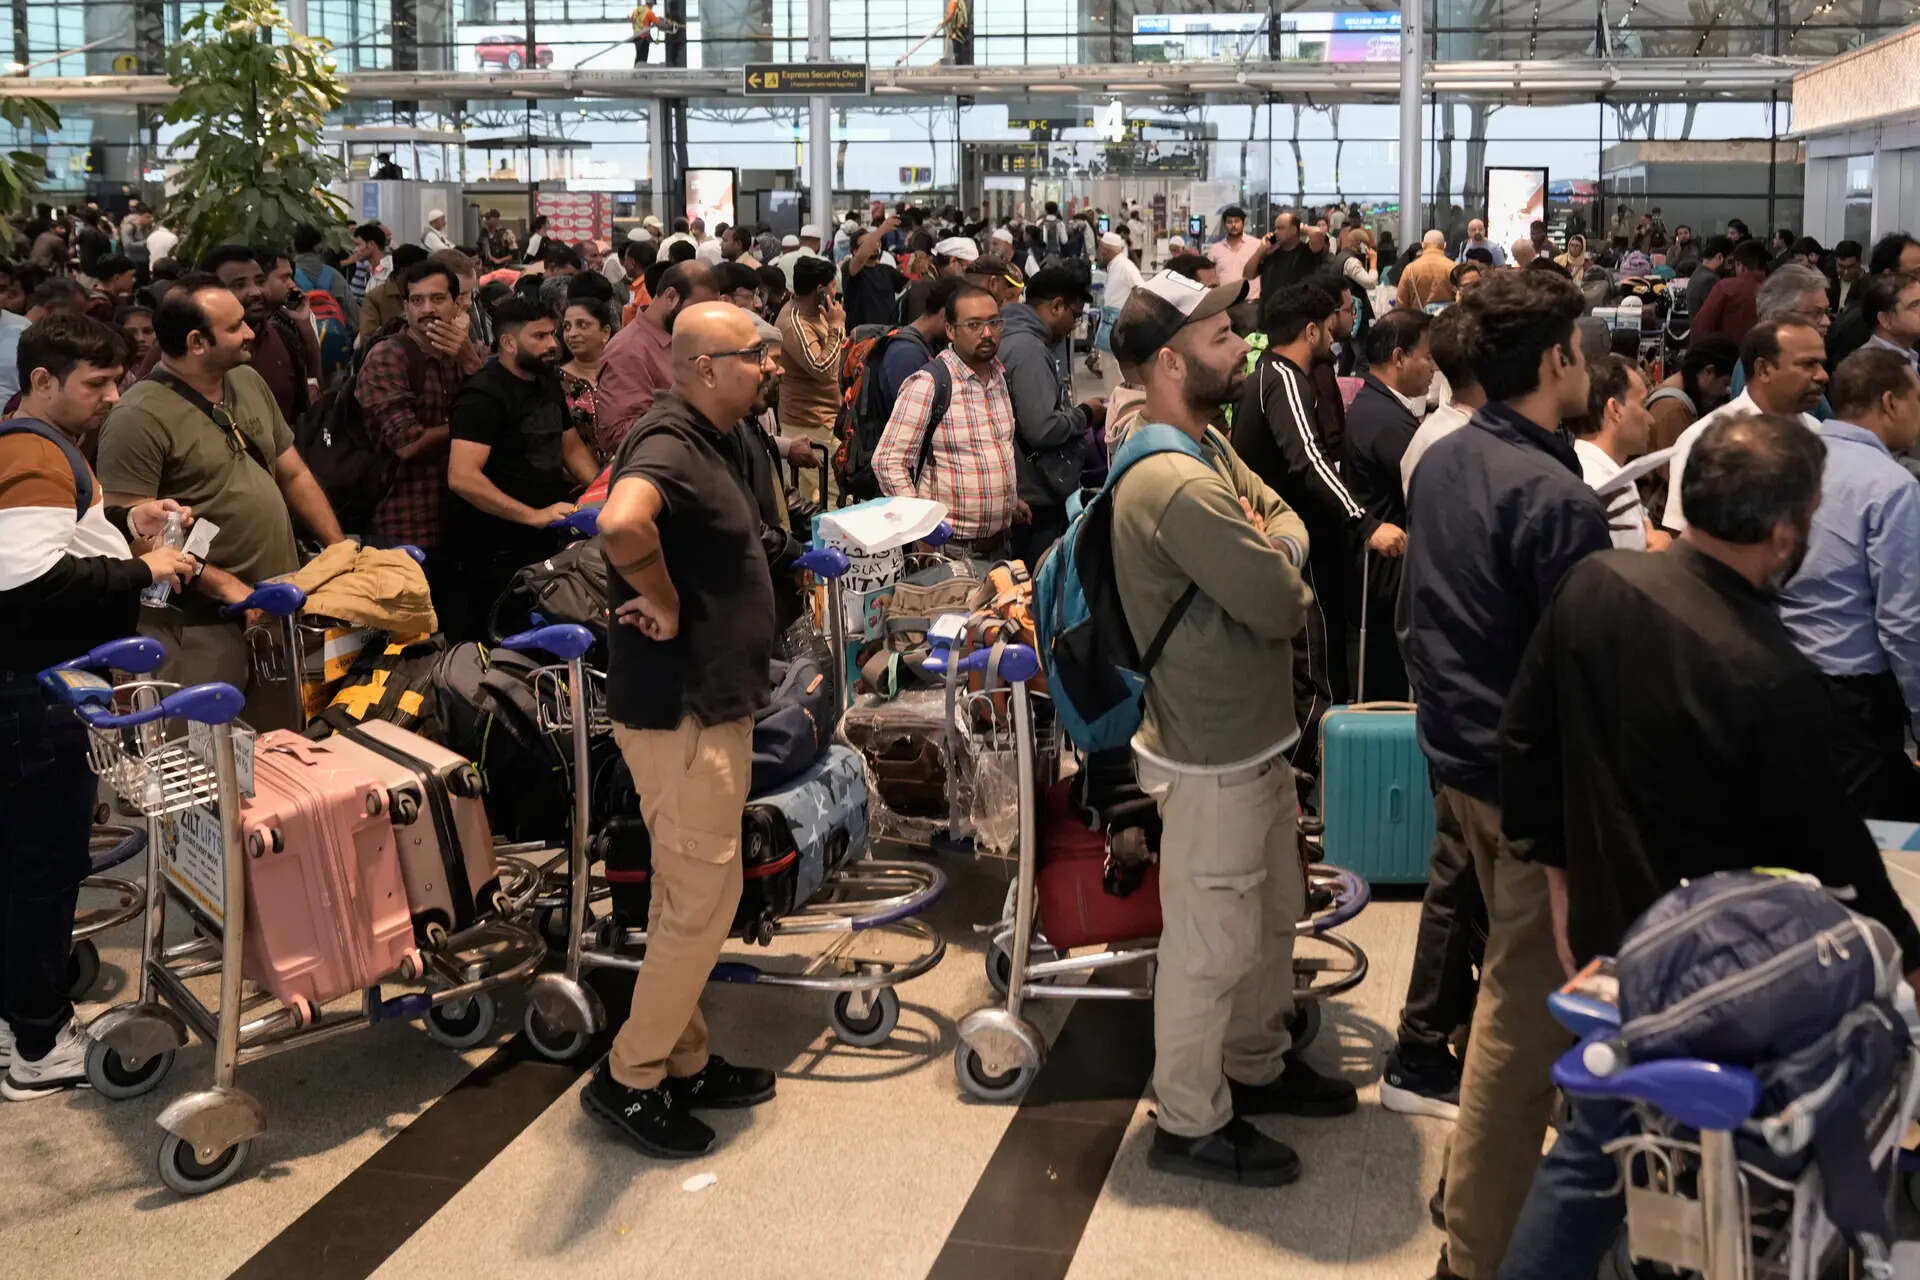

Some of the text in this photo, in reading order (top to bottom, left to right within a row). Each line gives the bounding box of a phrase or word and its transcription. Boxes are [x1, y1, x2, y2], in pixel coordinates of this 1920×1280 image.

[782, 70, 864, 80] Express Security Check
[1097, 101, 1126, 142] 4
